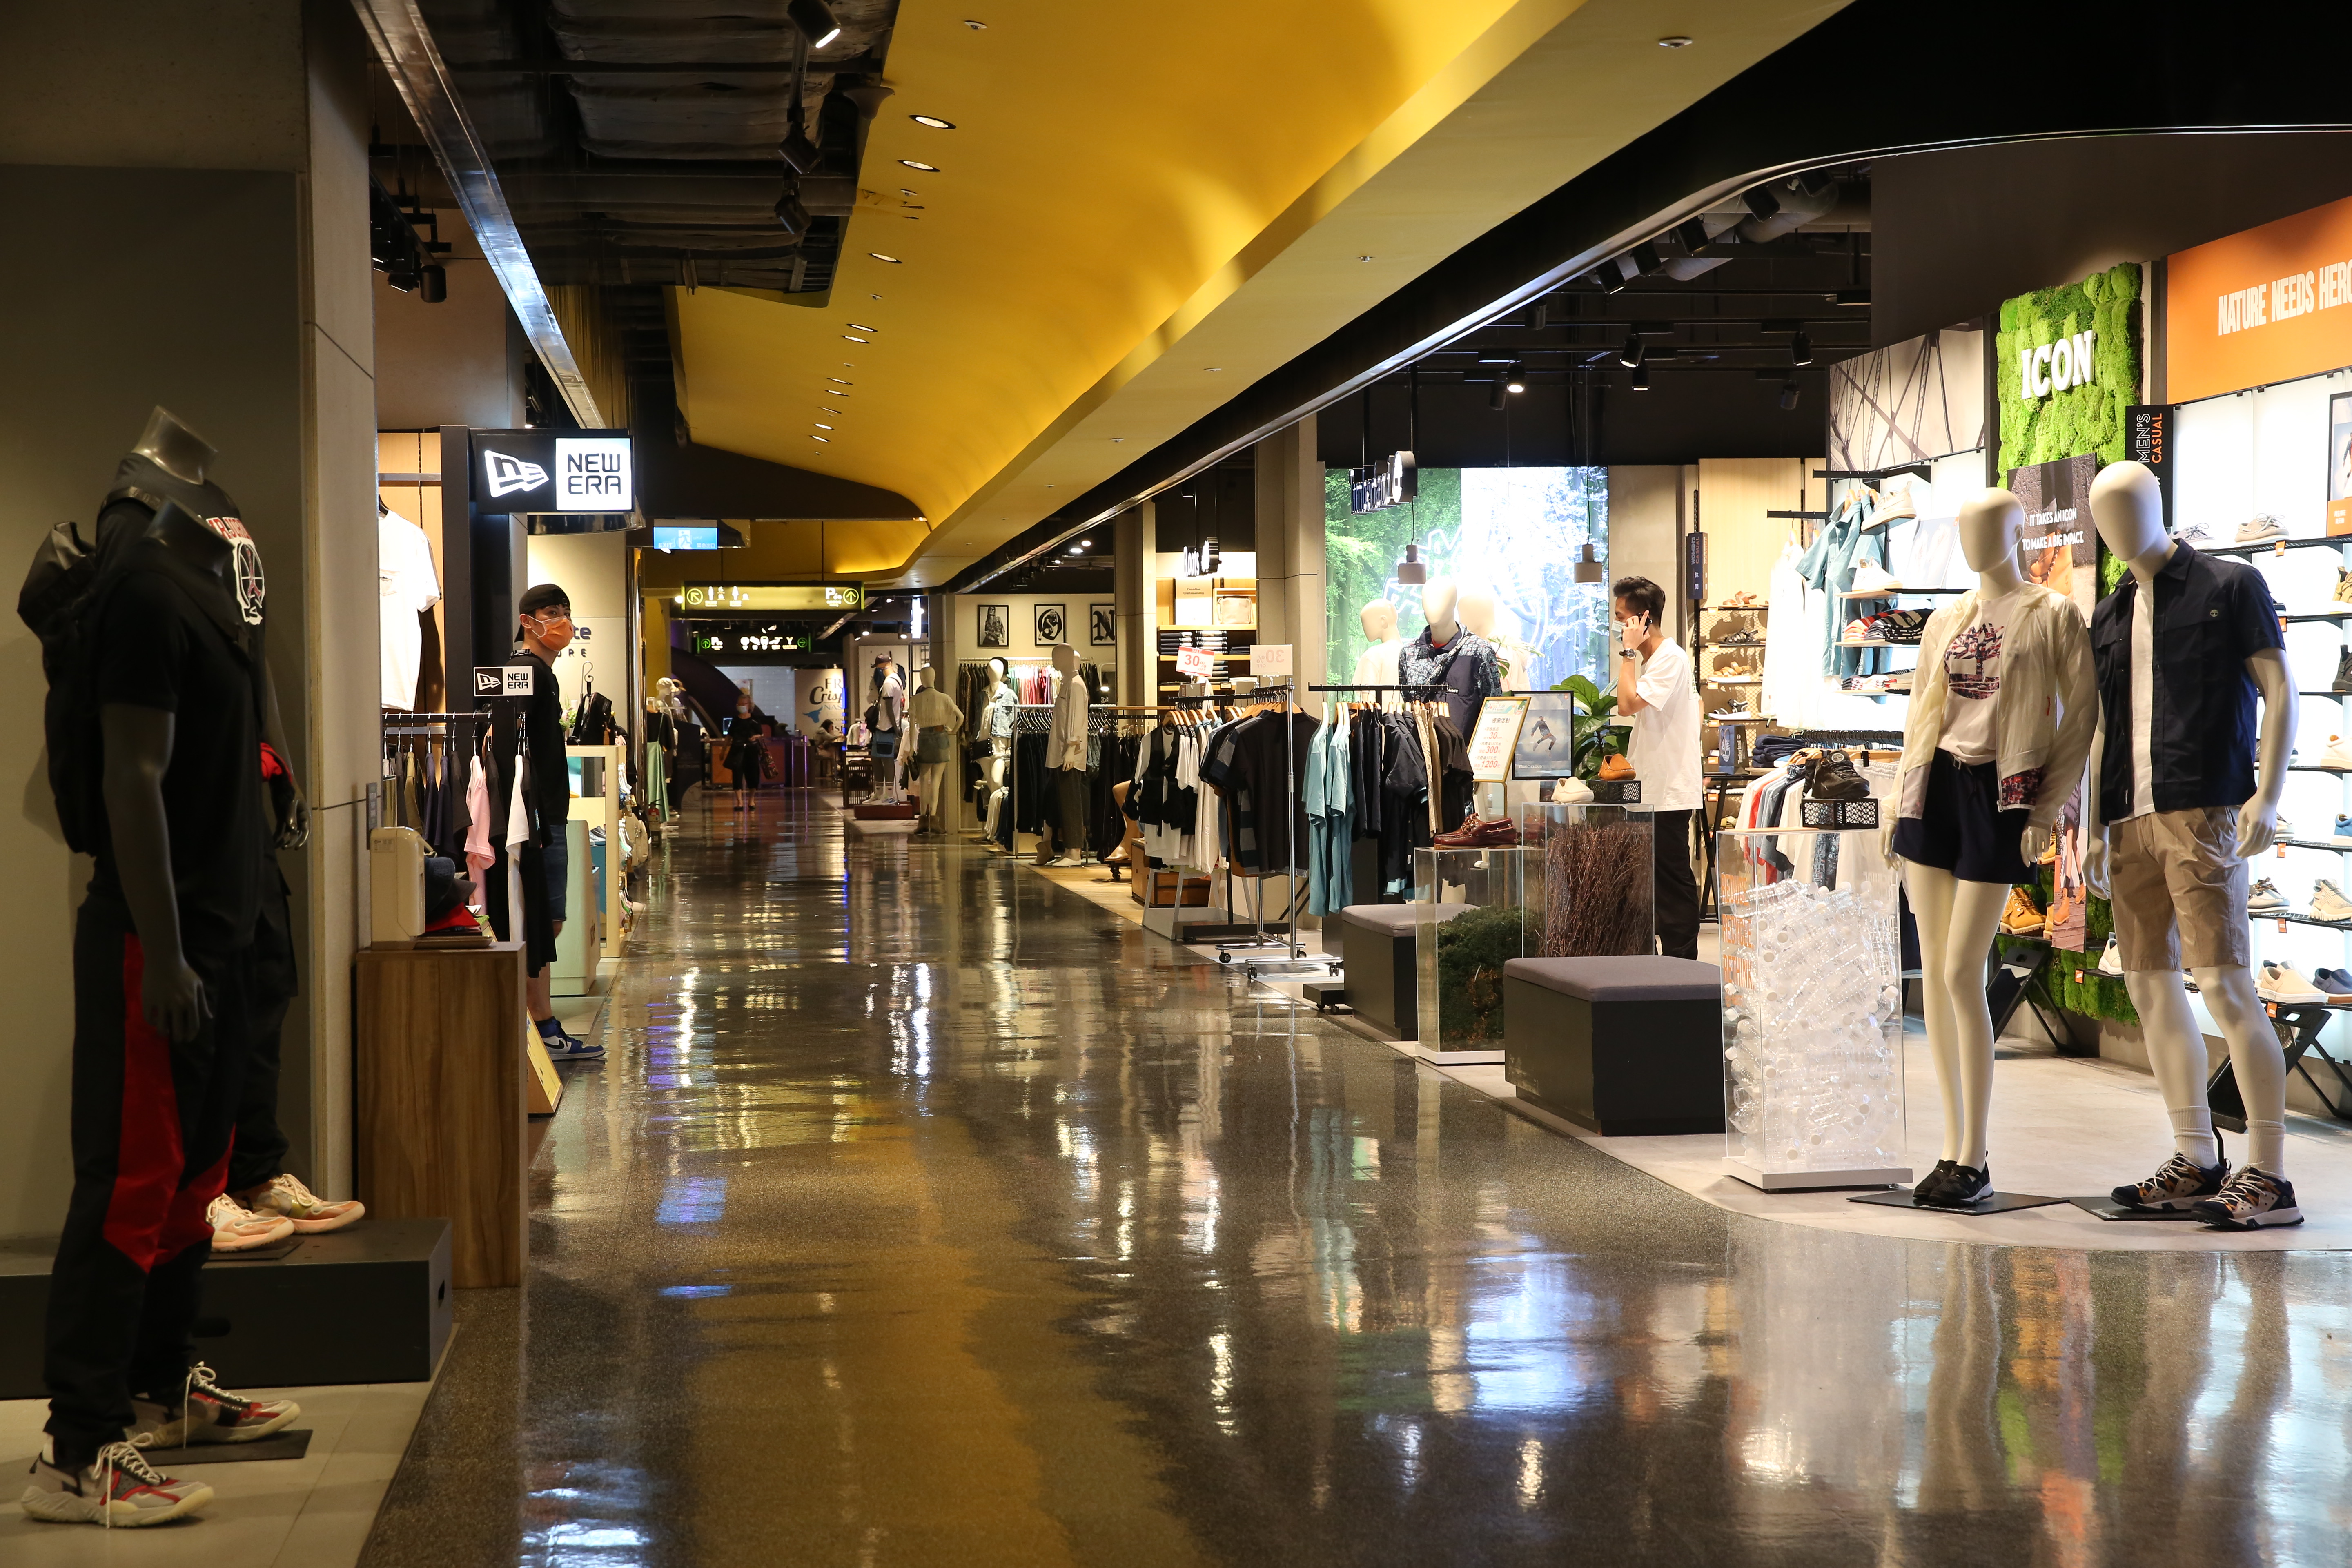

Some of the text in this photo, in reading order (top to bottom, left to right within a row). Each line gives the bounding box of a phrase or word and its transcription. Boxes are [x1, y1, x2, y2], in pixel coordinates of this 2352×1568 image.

[2218, 283, 2267, 336] NATURE
[2272, 270, 2315, 322] NEEDS
[2021, 330, 2096, 399] ICON
[2152, 413, 2162, 463] CASUAL
[568, 453, 621, 473] NEW
[568, 475, 621, 495] ERA
[2029, 508, 2077, 527] IT TAKES AN ICON
[2022, 531, 2084, 551] TO MAKE A BIG IMPACT.
